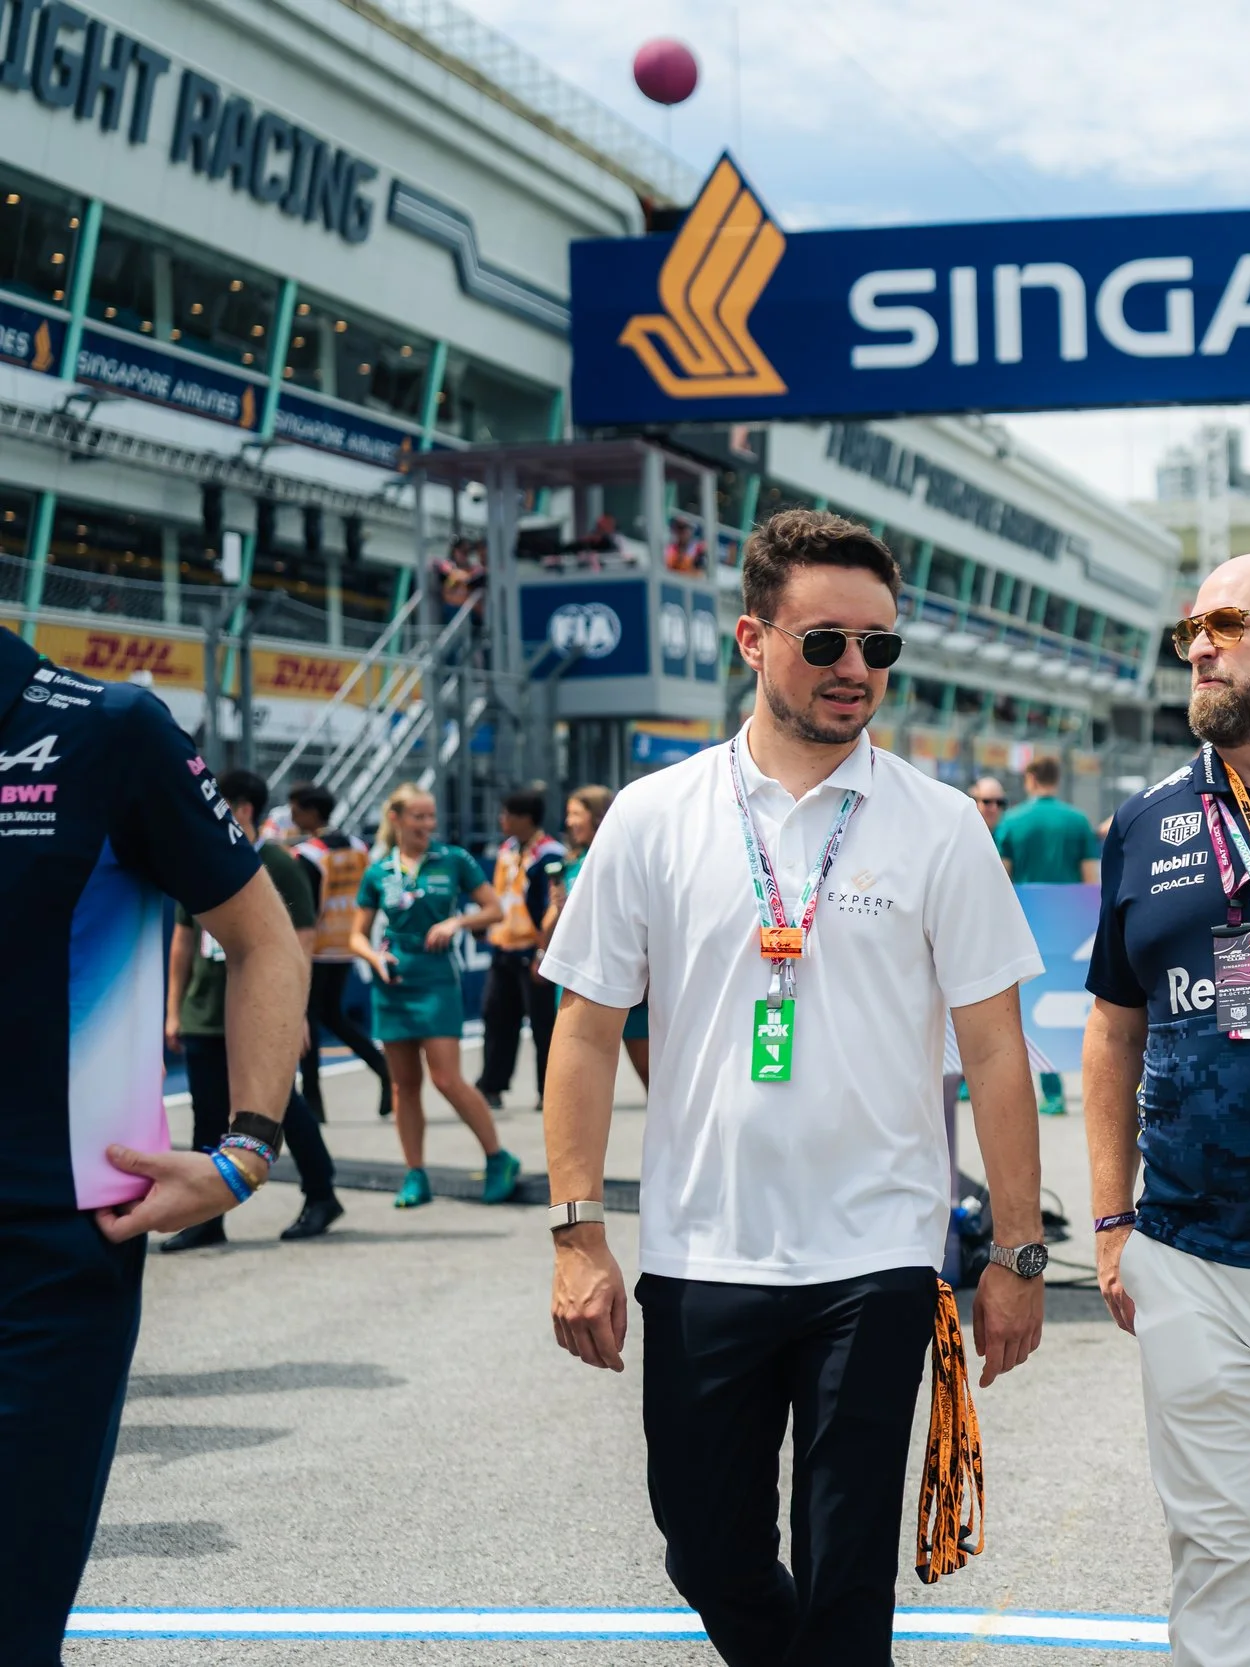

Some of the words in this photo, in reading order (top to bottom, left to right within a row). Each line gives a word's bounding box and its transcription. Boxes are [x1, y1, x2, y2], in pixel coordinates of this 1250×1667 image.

[168, 67, 380, 245] RACING
[77, 350, 171, 398] SINGAPORE
[551, 613, 615, 648] FIA
[83, 634, 177, 676] DHL
[53, 674, 104, 693] Microsoft
[2, 784, 57, 803] BWT
[1167, 814, 1199, 827] TAG
[1163, 825, 1199, 845] HEUER
[1151, 853, 1190, 876] Mobil
[1151, 874, 1205, 895] ORACLE
[827, 891, 895, 910] EXPERT
[839, 906, 879, 917] HOSTS
[1167, 966, 1216, 1015] Re
